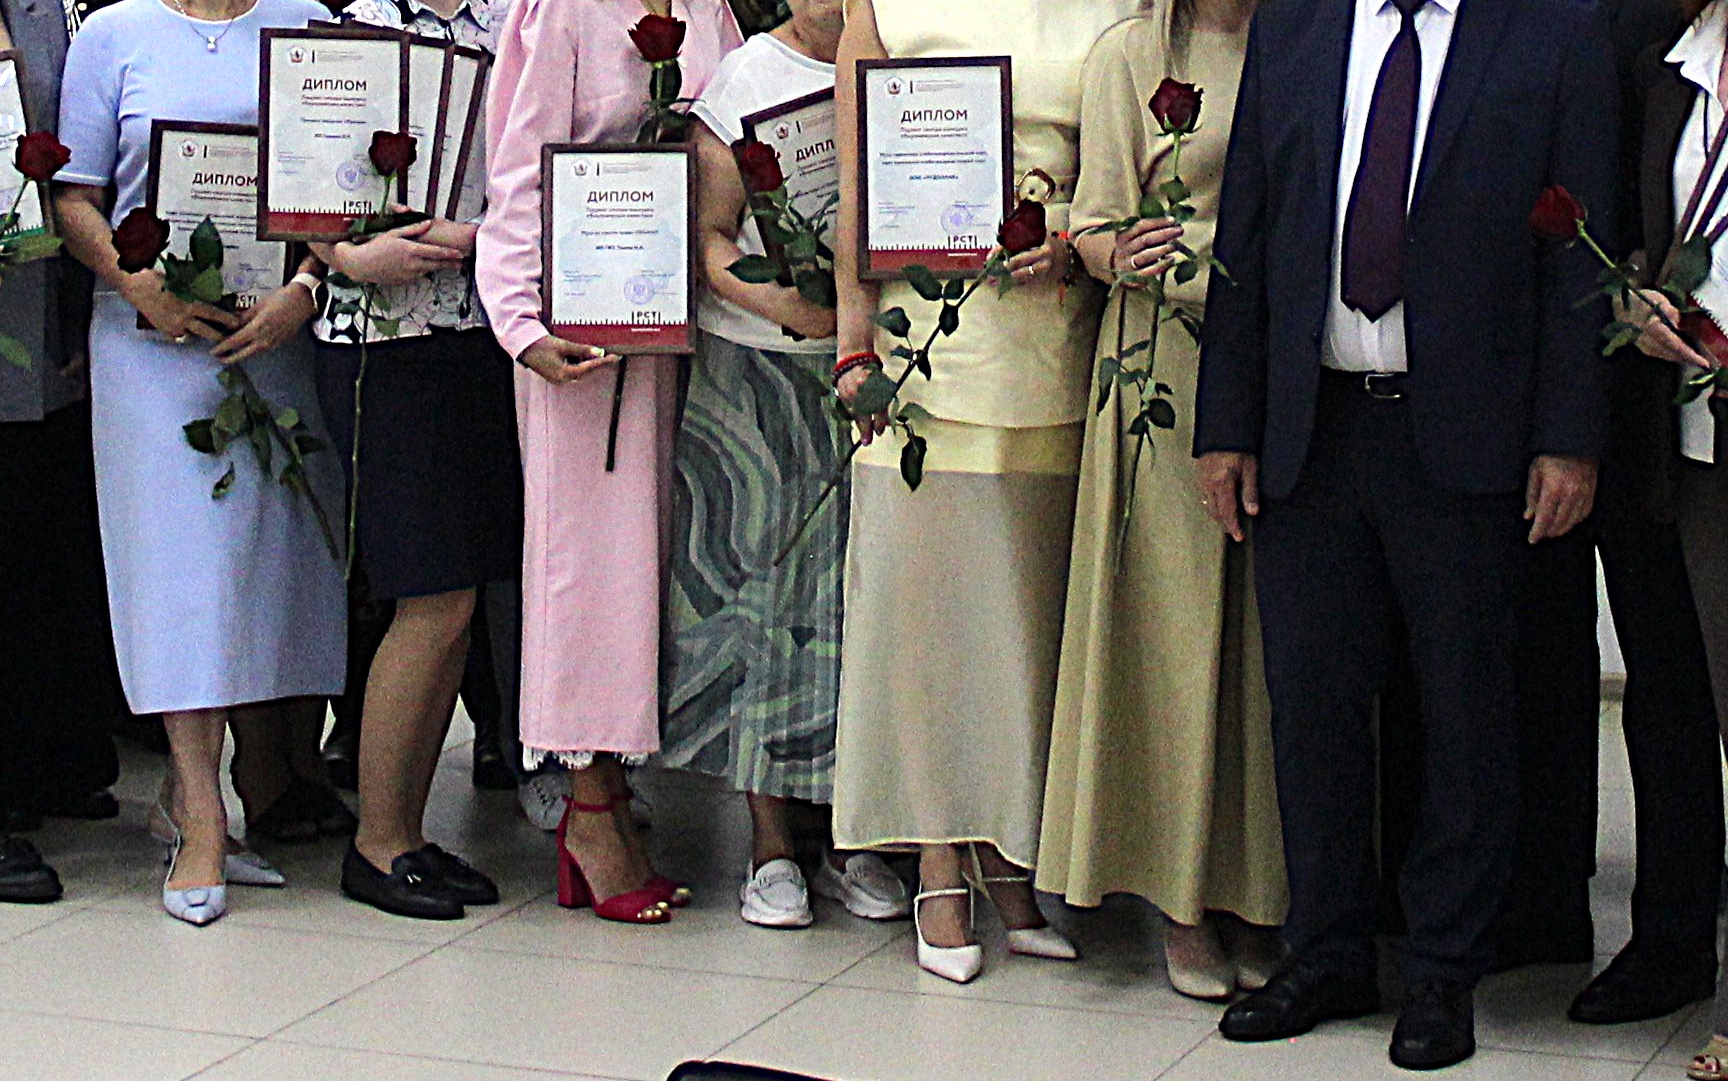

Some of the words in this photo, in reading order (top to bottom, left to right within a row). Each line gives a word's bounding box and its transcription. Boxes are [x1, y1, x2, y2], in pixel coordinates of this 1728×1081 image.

[302, 79, 367, 92] ДИПЛОМ
[901, 109, 968, 123] ДИПЛОМ
[795, 139, 835, 162] ДИПЛ
[192, 172, 258, 187] ДИПЛОМ
[587, 190, 654, 203] ДИПЛОМ
